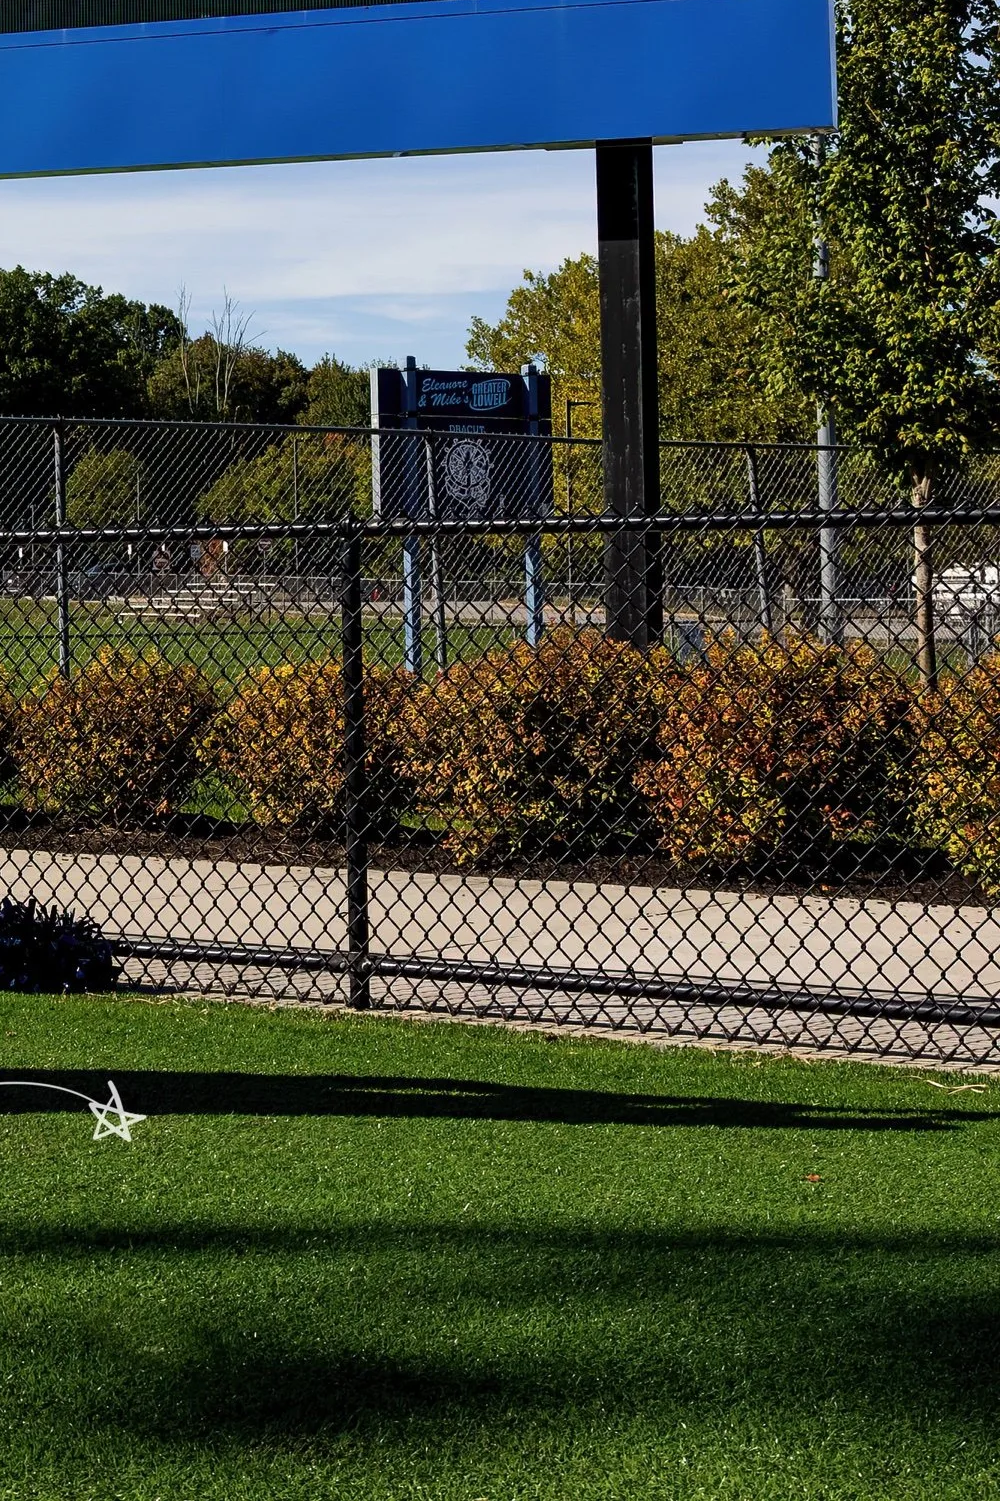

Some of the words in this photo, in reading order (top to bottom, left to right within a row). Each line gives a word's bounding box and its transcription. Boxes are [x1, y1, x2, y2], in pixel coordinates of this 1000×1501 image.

[418, 394, 427, 407] &
[431, 391, 469, 406] Mike's
[473, 393, 508, 407] LOWELL
